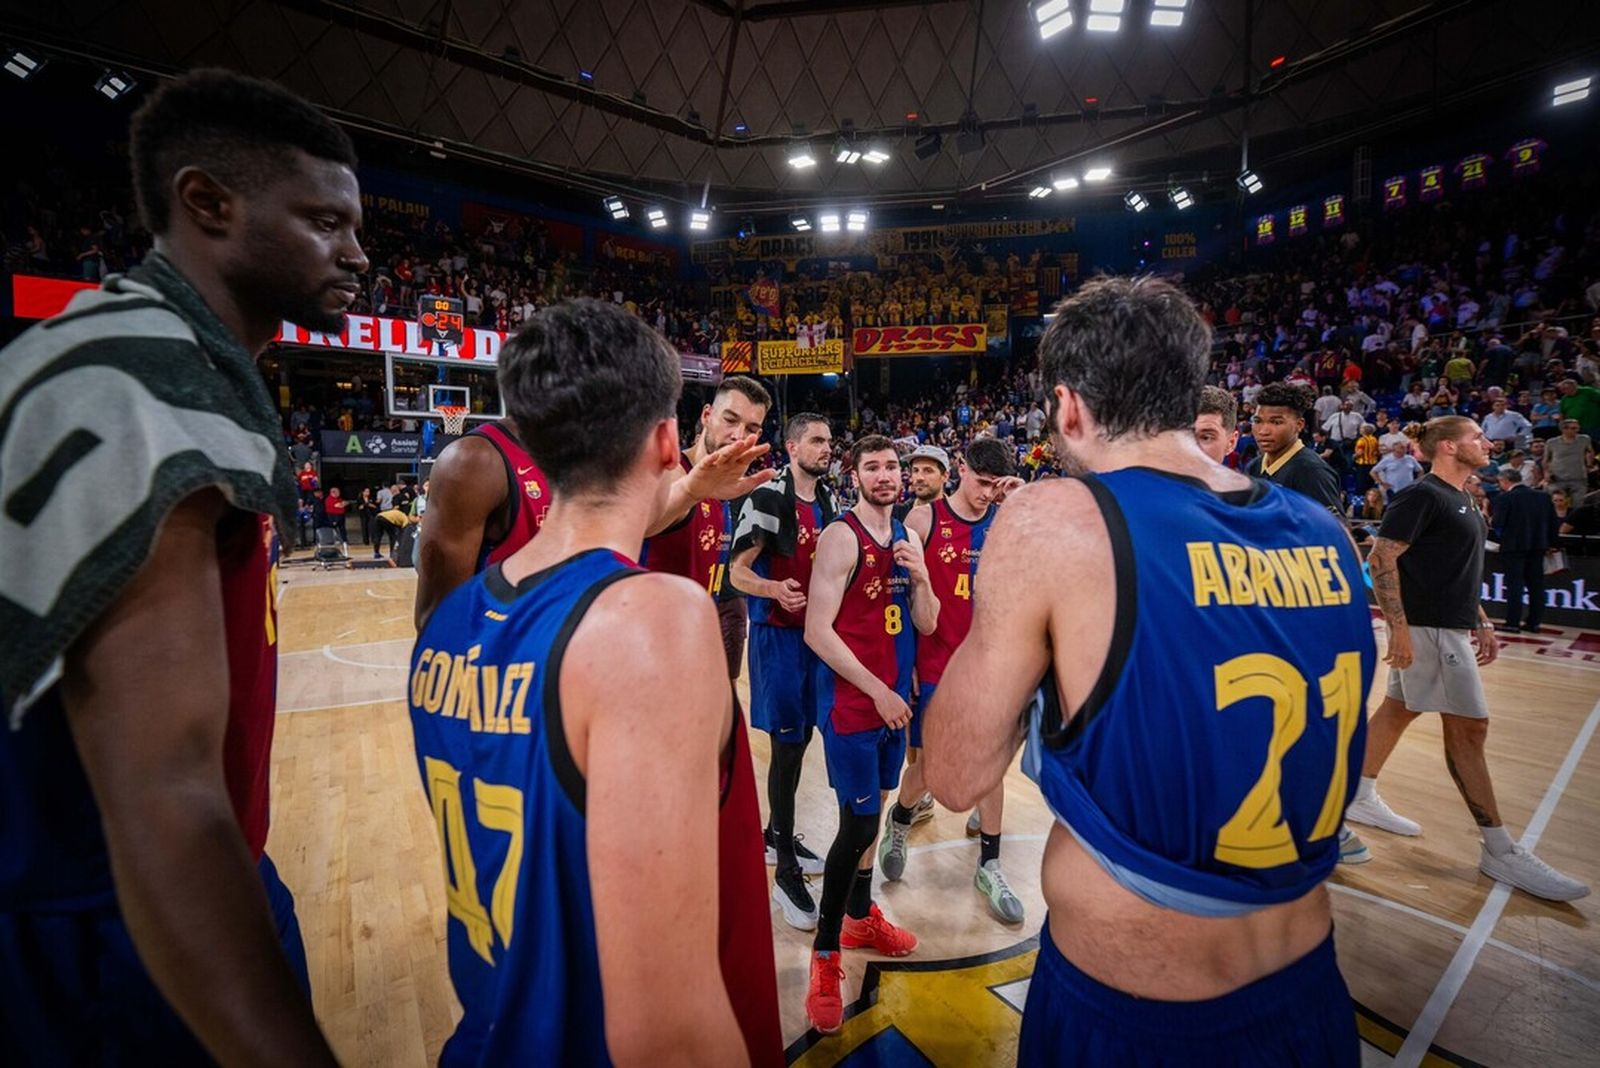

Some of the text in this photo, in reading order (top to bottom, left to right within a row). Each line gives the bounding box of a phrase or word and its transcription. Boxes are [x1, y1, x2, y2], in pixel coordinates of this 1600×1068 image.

[1519, 148, 1532, 162] 9
[1388, 184, 1400, 197] 7
[438, 313, 460, 331] 24
[854, 325, 984, 353] DRACS
[345, 434, 363, 454] A
[954, 573, 970, 600] 4
[1186, 541, 1351, 607] ABRINES
[884, 603, 903, 635] 8
[1213, 651, 1361, 869] 21
[424, 756, 524, 967] 47
